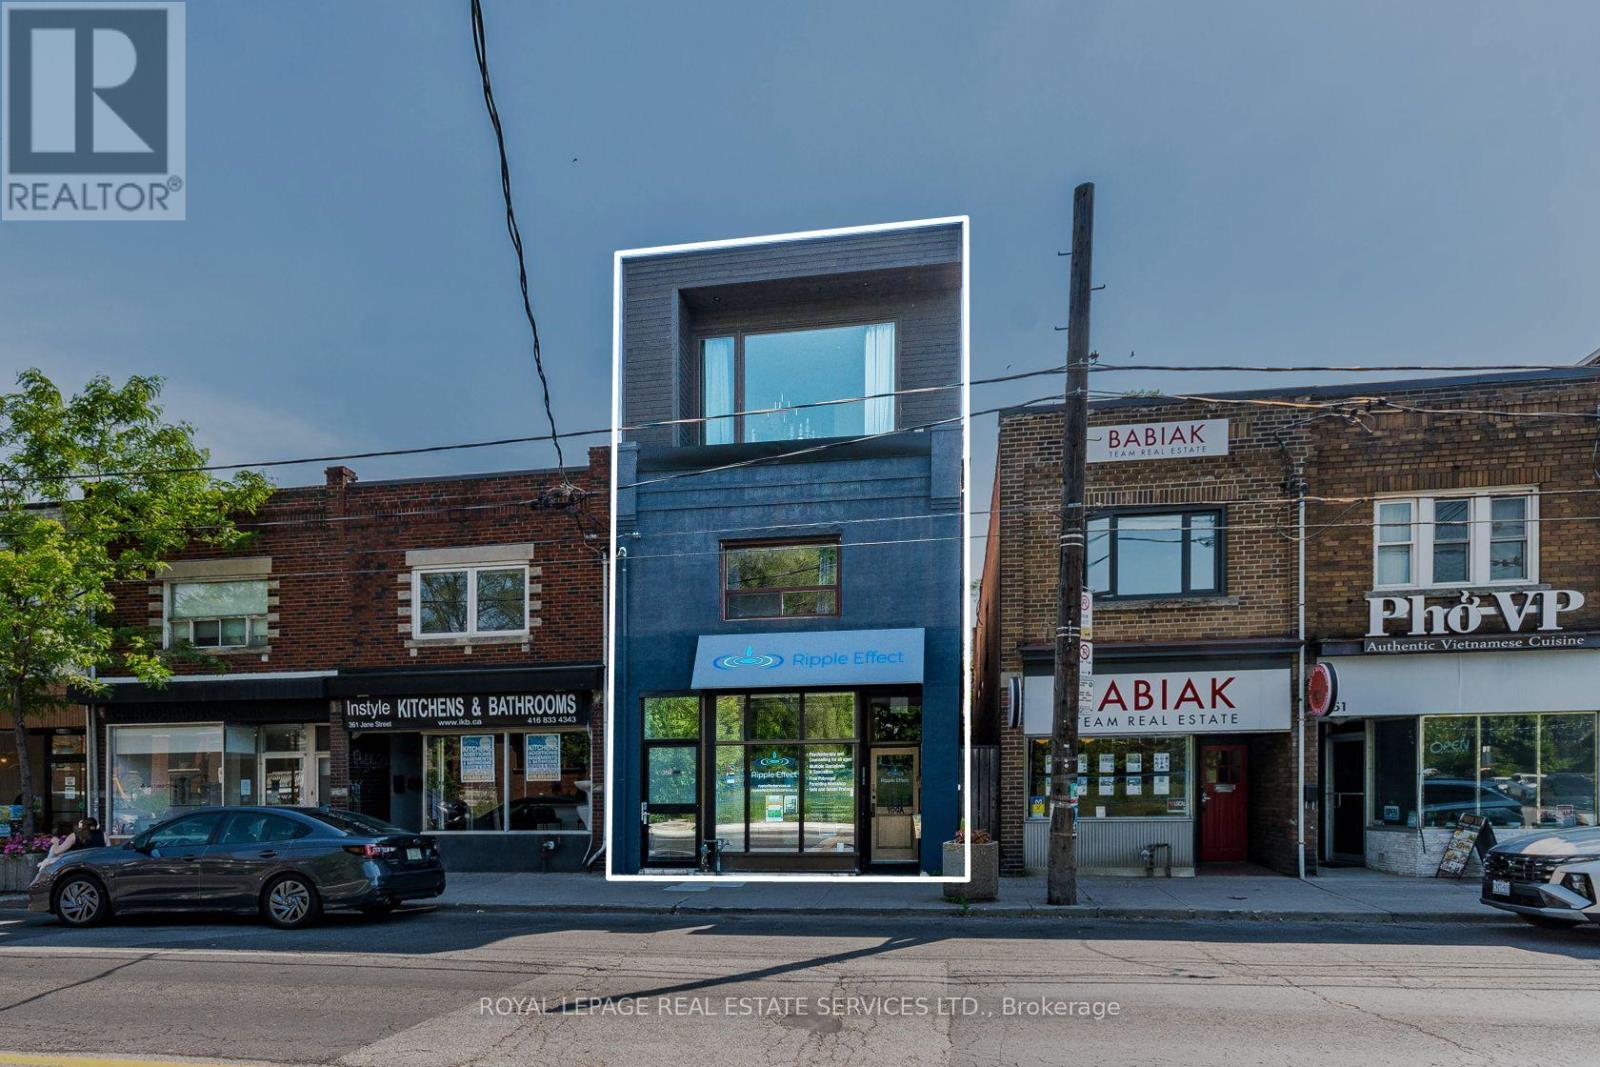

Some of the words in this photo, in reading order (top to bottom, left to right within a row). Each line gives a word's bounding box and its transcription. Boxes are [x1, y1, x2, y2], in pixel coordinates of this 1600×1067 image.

[1108, 424, 1206, 449] BABIAK
[1108, 450, 1136, 458] TEAM
[1141, 448, 1165, 456] REAL
[1171, 446, 1206, 454] ESTATE
[1491, 589, 1585, 632] VP
[1368, 640, 1435, 652] Authentic
[1441, 638, 1523, 650] Vietnamese
[1529, 635, 1585, 647] Cuisine
[792, 652, 849, 669] Ripple
[854, 650, 905, 665] Effect
[1097, 676, 1236, 712] ABIAK
[346, 700, 391, 719] Instyle
[397, 696, 465, 718] KITCHENS
[471, 696, 482, 716] &
[488, 693, 577, 716] BATHROOMS
[374, 720, 392, 728] Street
[557, 715, 577, 723] 4343
[1128, 715, 1168, 726] REAL
[1178, 713, 1239, 725] ESTATE
[751, 770, 775, 780] Ripple
[776, 769, 798, 779] Effect
